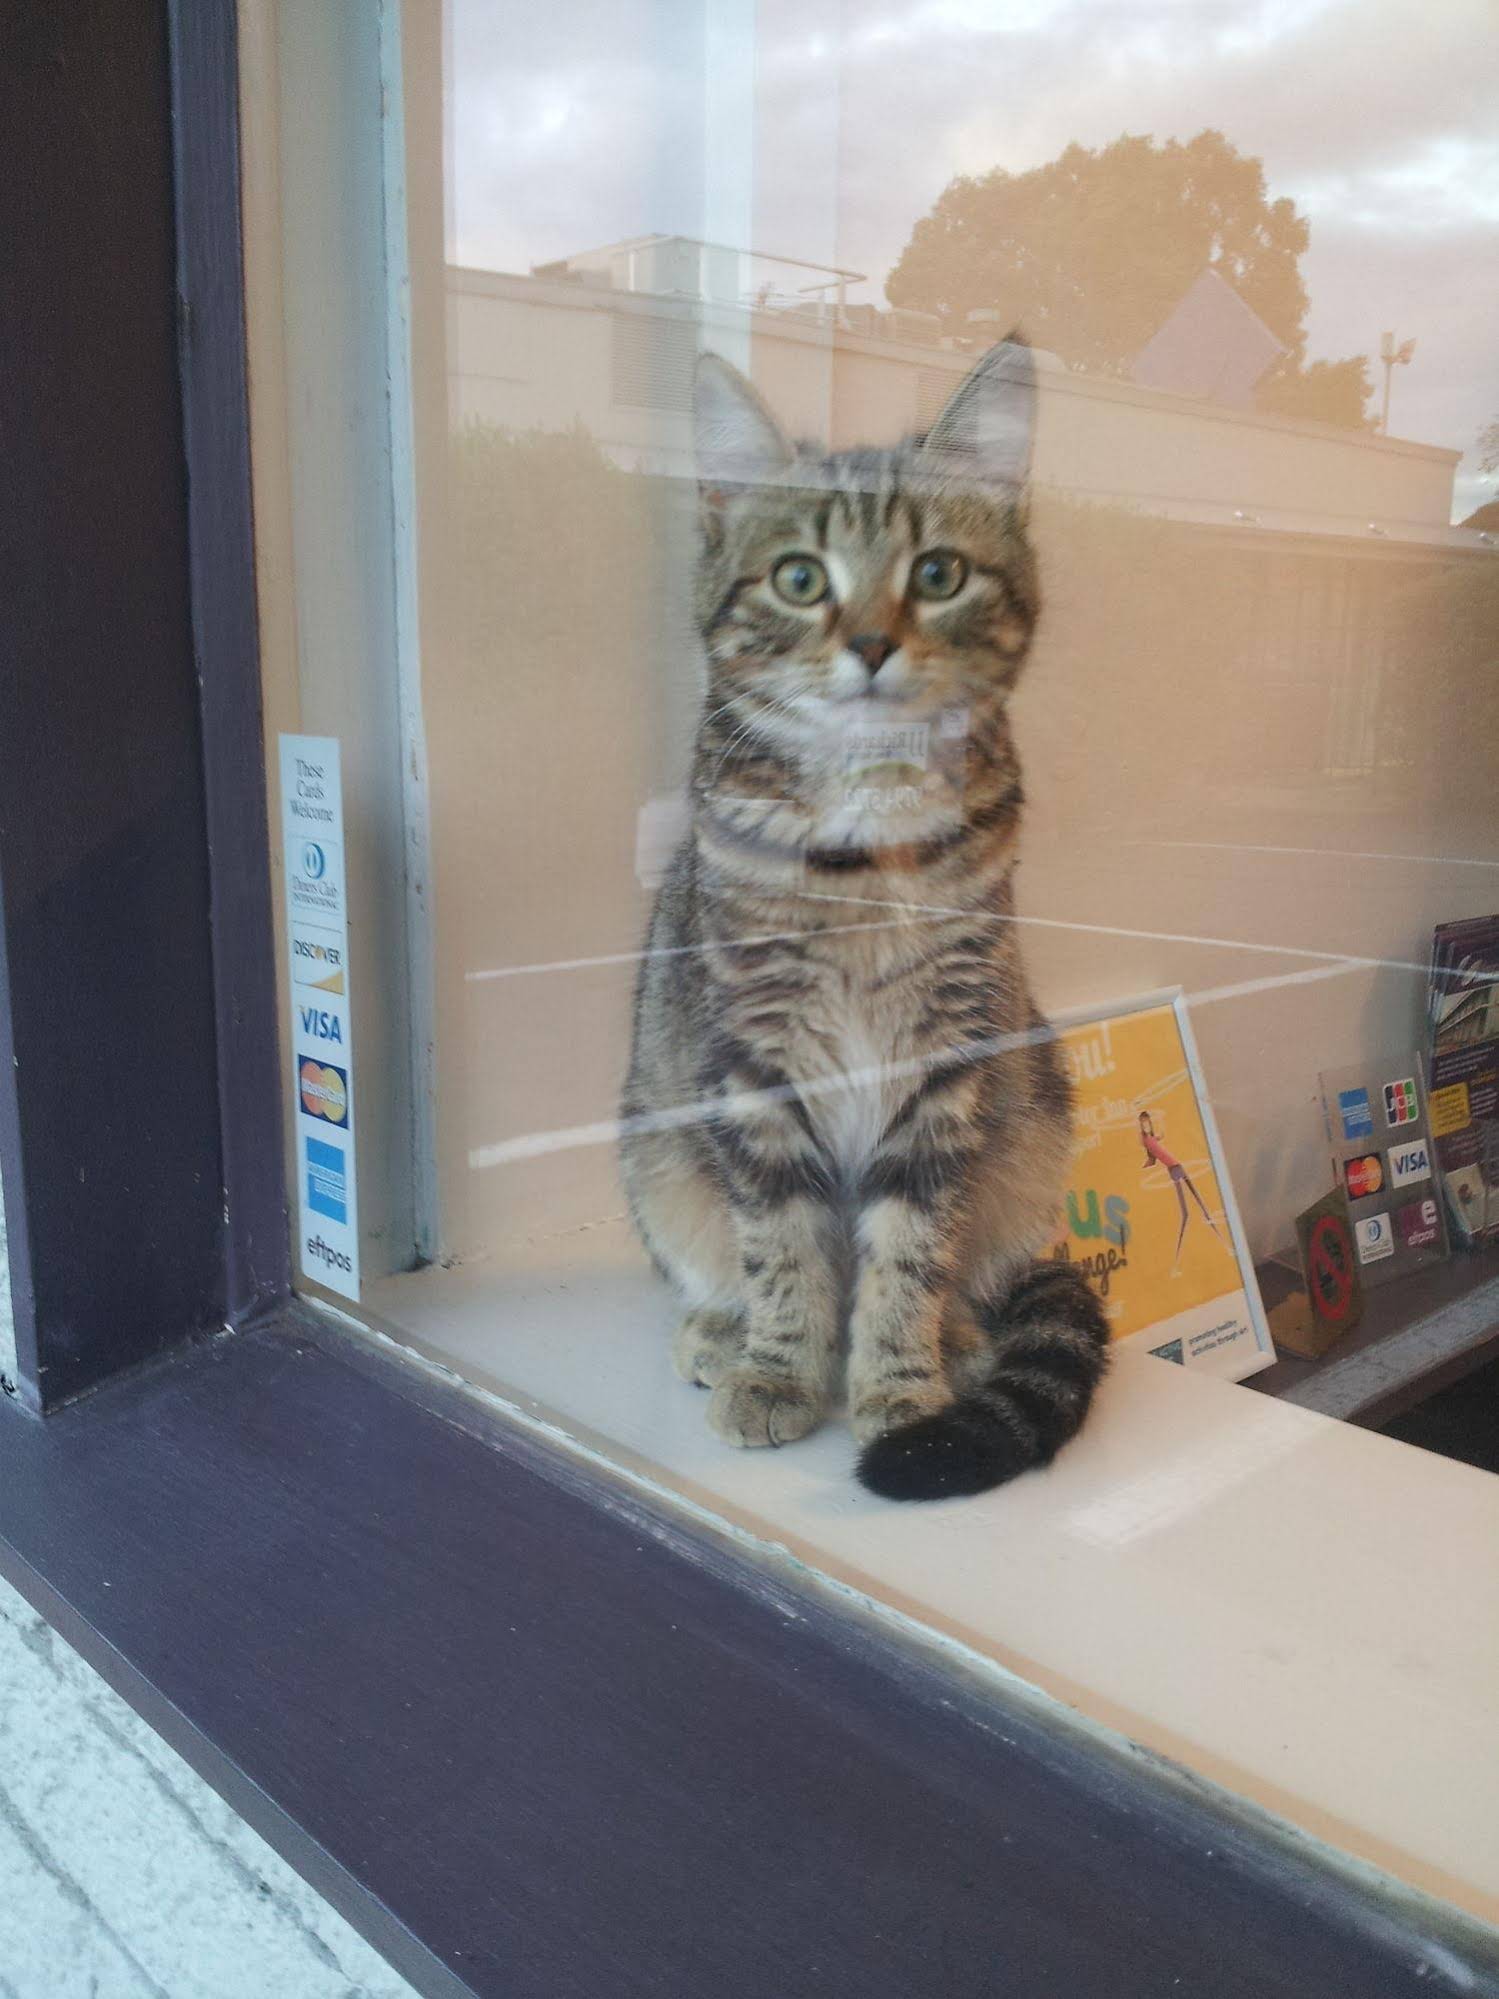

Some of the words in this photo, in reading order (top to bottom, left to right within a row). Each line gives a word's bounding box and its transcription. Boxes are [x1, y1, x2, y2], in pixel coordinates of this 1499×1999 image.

[289, 800, 334, 823] Welcome
[294, 940, 341, 965] DISCOVER
[300, 1005, 342, 1044] VISA
[1394, 1151, 1429, 1175] VISA
[307, 1235, 352, 1273] eftpos
